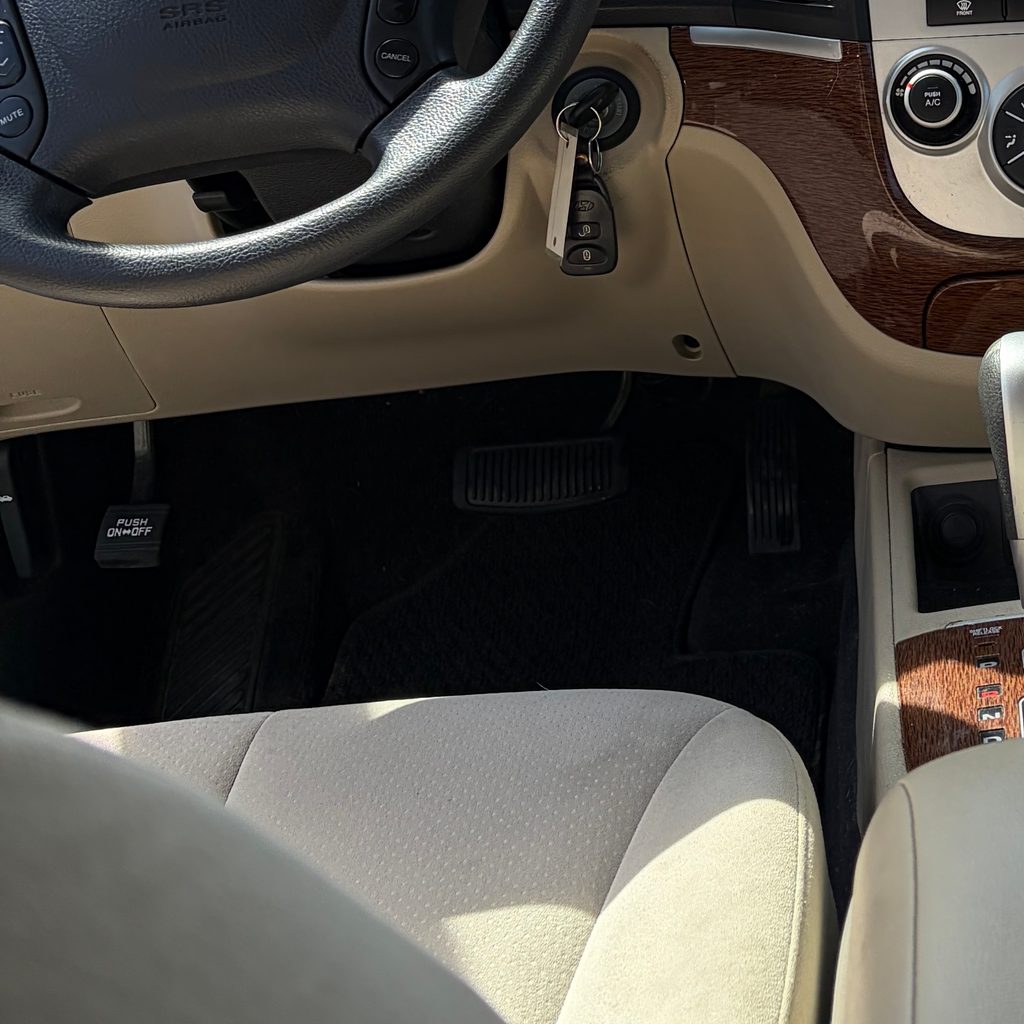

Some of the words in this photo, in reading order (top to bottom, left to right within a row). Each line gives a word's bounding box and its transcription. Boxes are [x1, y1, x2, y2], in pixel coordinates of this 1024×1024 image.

[159, 0, 227, 20] SRS
[163, 15, 229, 31] AIRBAG
[380, 51, 412, 63] CANCEL
[925, 97, 941, 107] A/C
[0, 108, 24, 125] MUTE
[116, 518, 149, 527] PUSH
